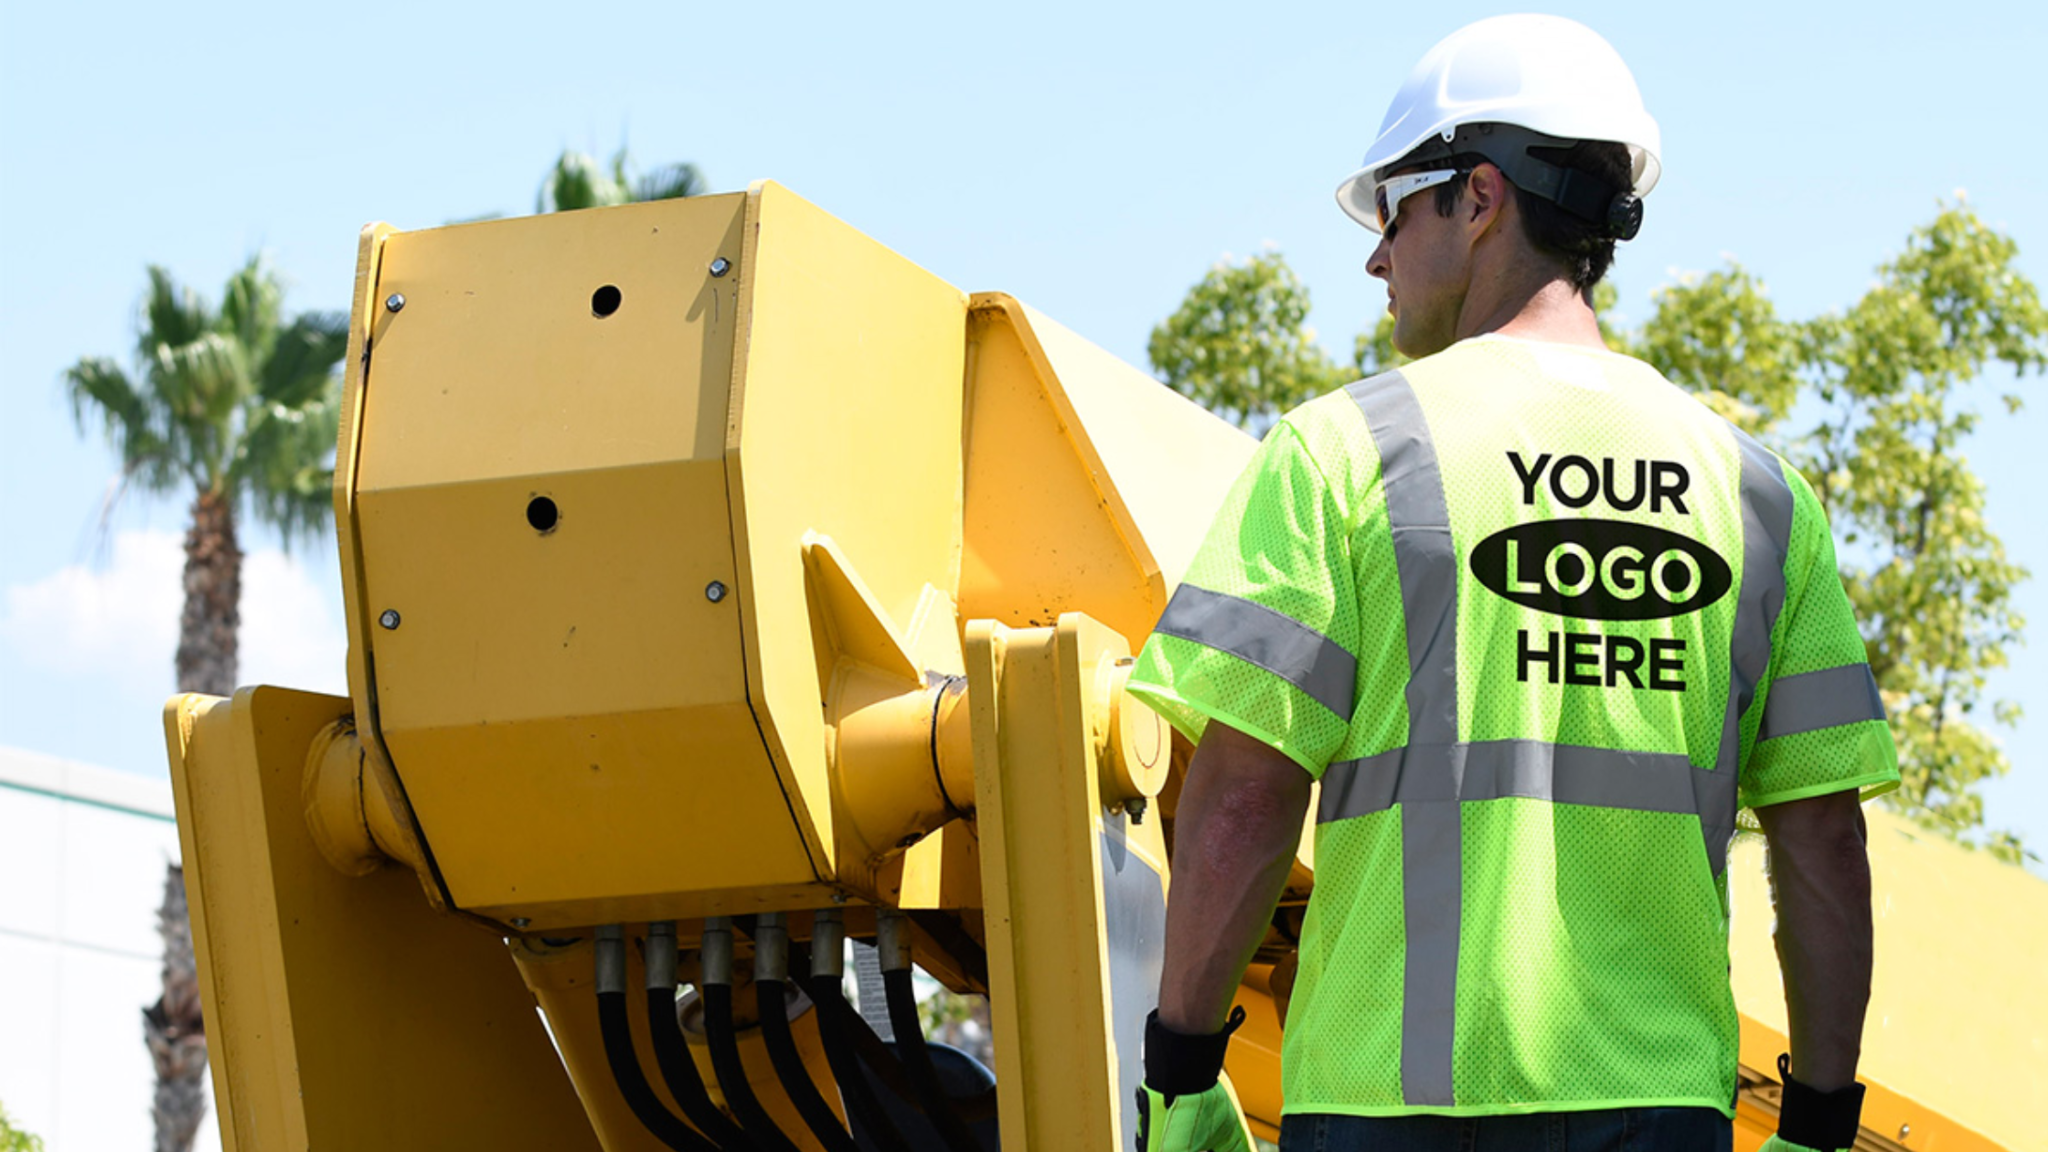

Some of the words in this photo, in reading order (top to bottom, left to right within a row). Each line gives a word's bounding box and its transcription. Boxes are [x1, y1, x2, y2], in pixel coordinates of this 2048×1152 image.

[1506, 451, 1690, 515] YOUR
[1506, 539, 1702, 604] LOGO
[1517, 630, 1687, 692] HERE
